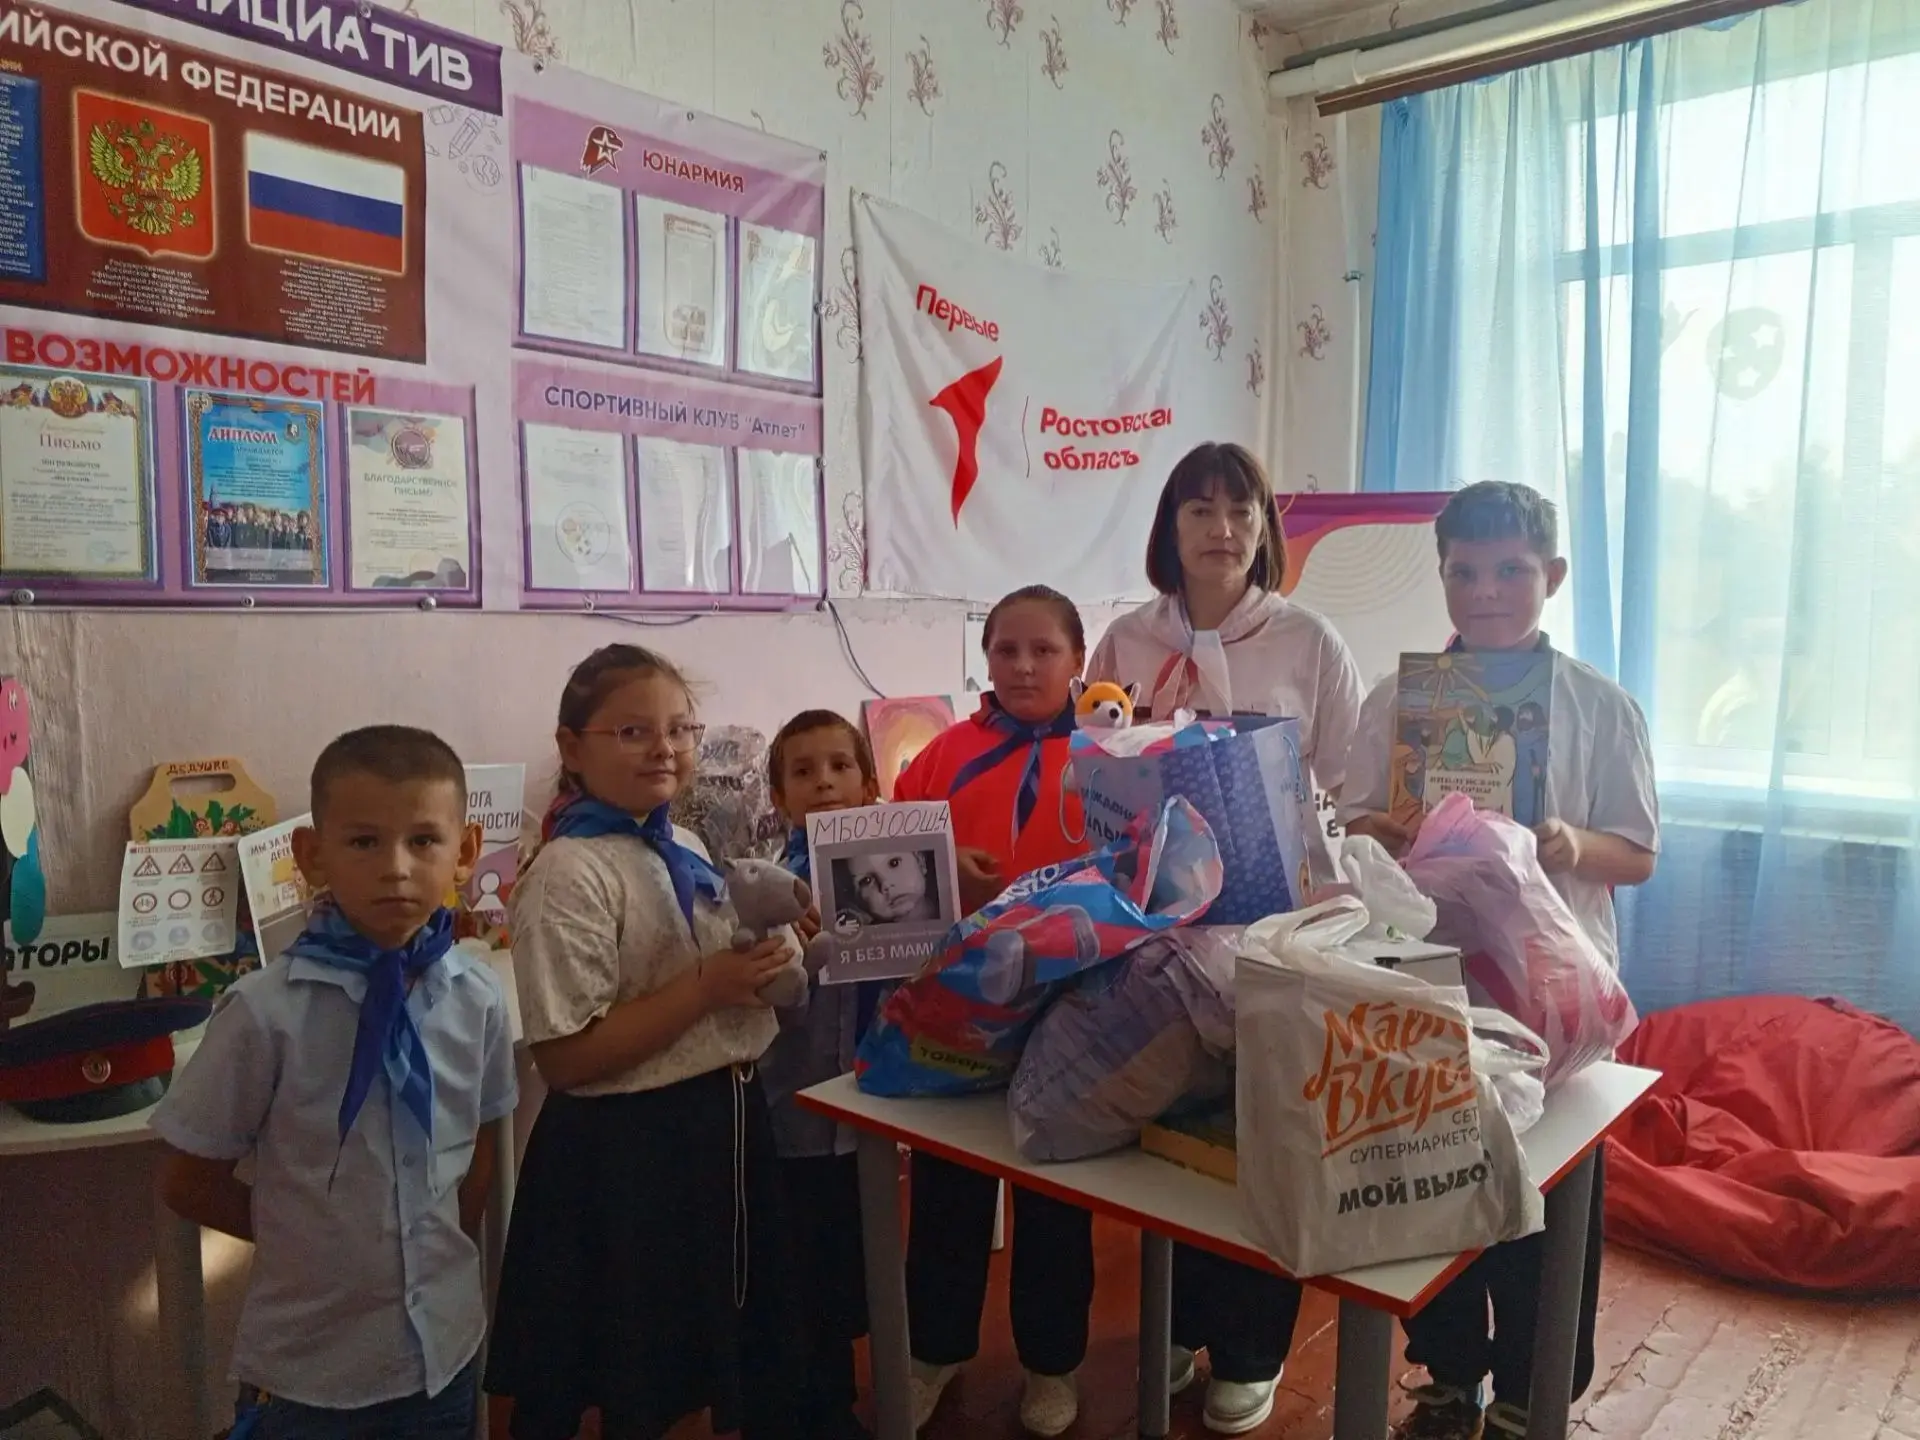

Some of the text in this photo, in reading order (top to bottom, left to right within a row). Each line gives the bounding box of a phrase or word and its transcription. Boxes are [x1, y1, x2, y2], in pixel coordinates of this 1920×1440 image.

[180, 60, 402, 142] ФЕДЕРАЦИИ
[641, 148, 745, 194] ЮНАРМИЯ
[916, 284, 1000, 342] Первые
[5, 329, 377, 405] ВОЗМОЖНОСТЕЙ
[544, 385, 688, 424] СПОРТИВНЫЙ
[693, 408, 740, 431] КЛУБ
[39, 432, 102, 451] Письмо
[207, 427, 279, 445] ДИПЛОМ
[393, 485, 434, 498] ПИСЬМО
[840, 943, 934, 965] Я БЕЗ МАМ
[1337, 1149, 1495, 1215] МОЙ ВЫБО
